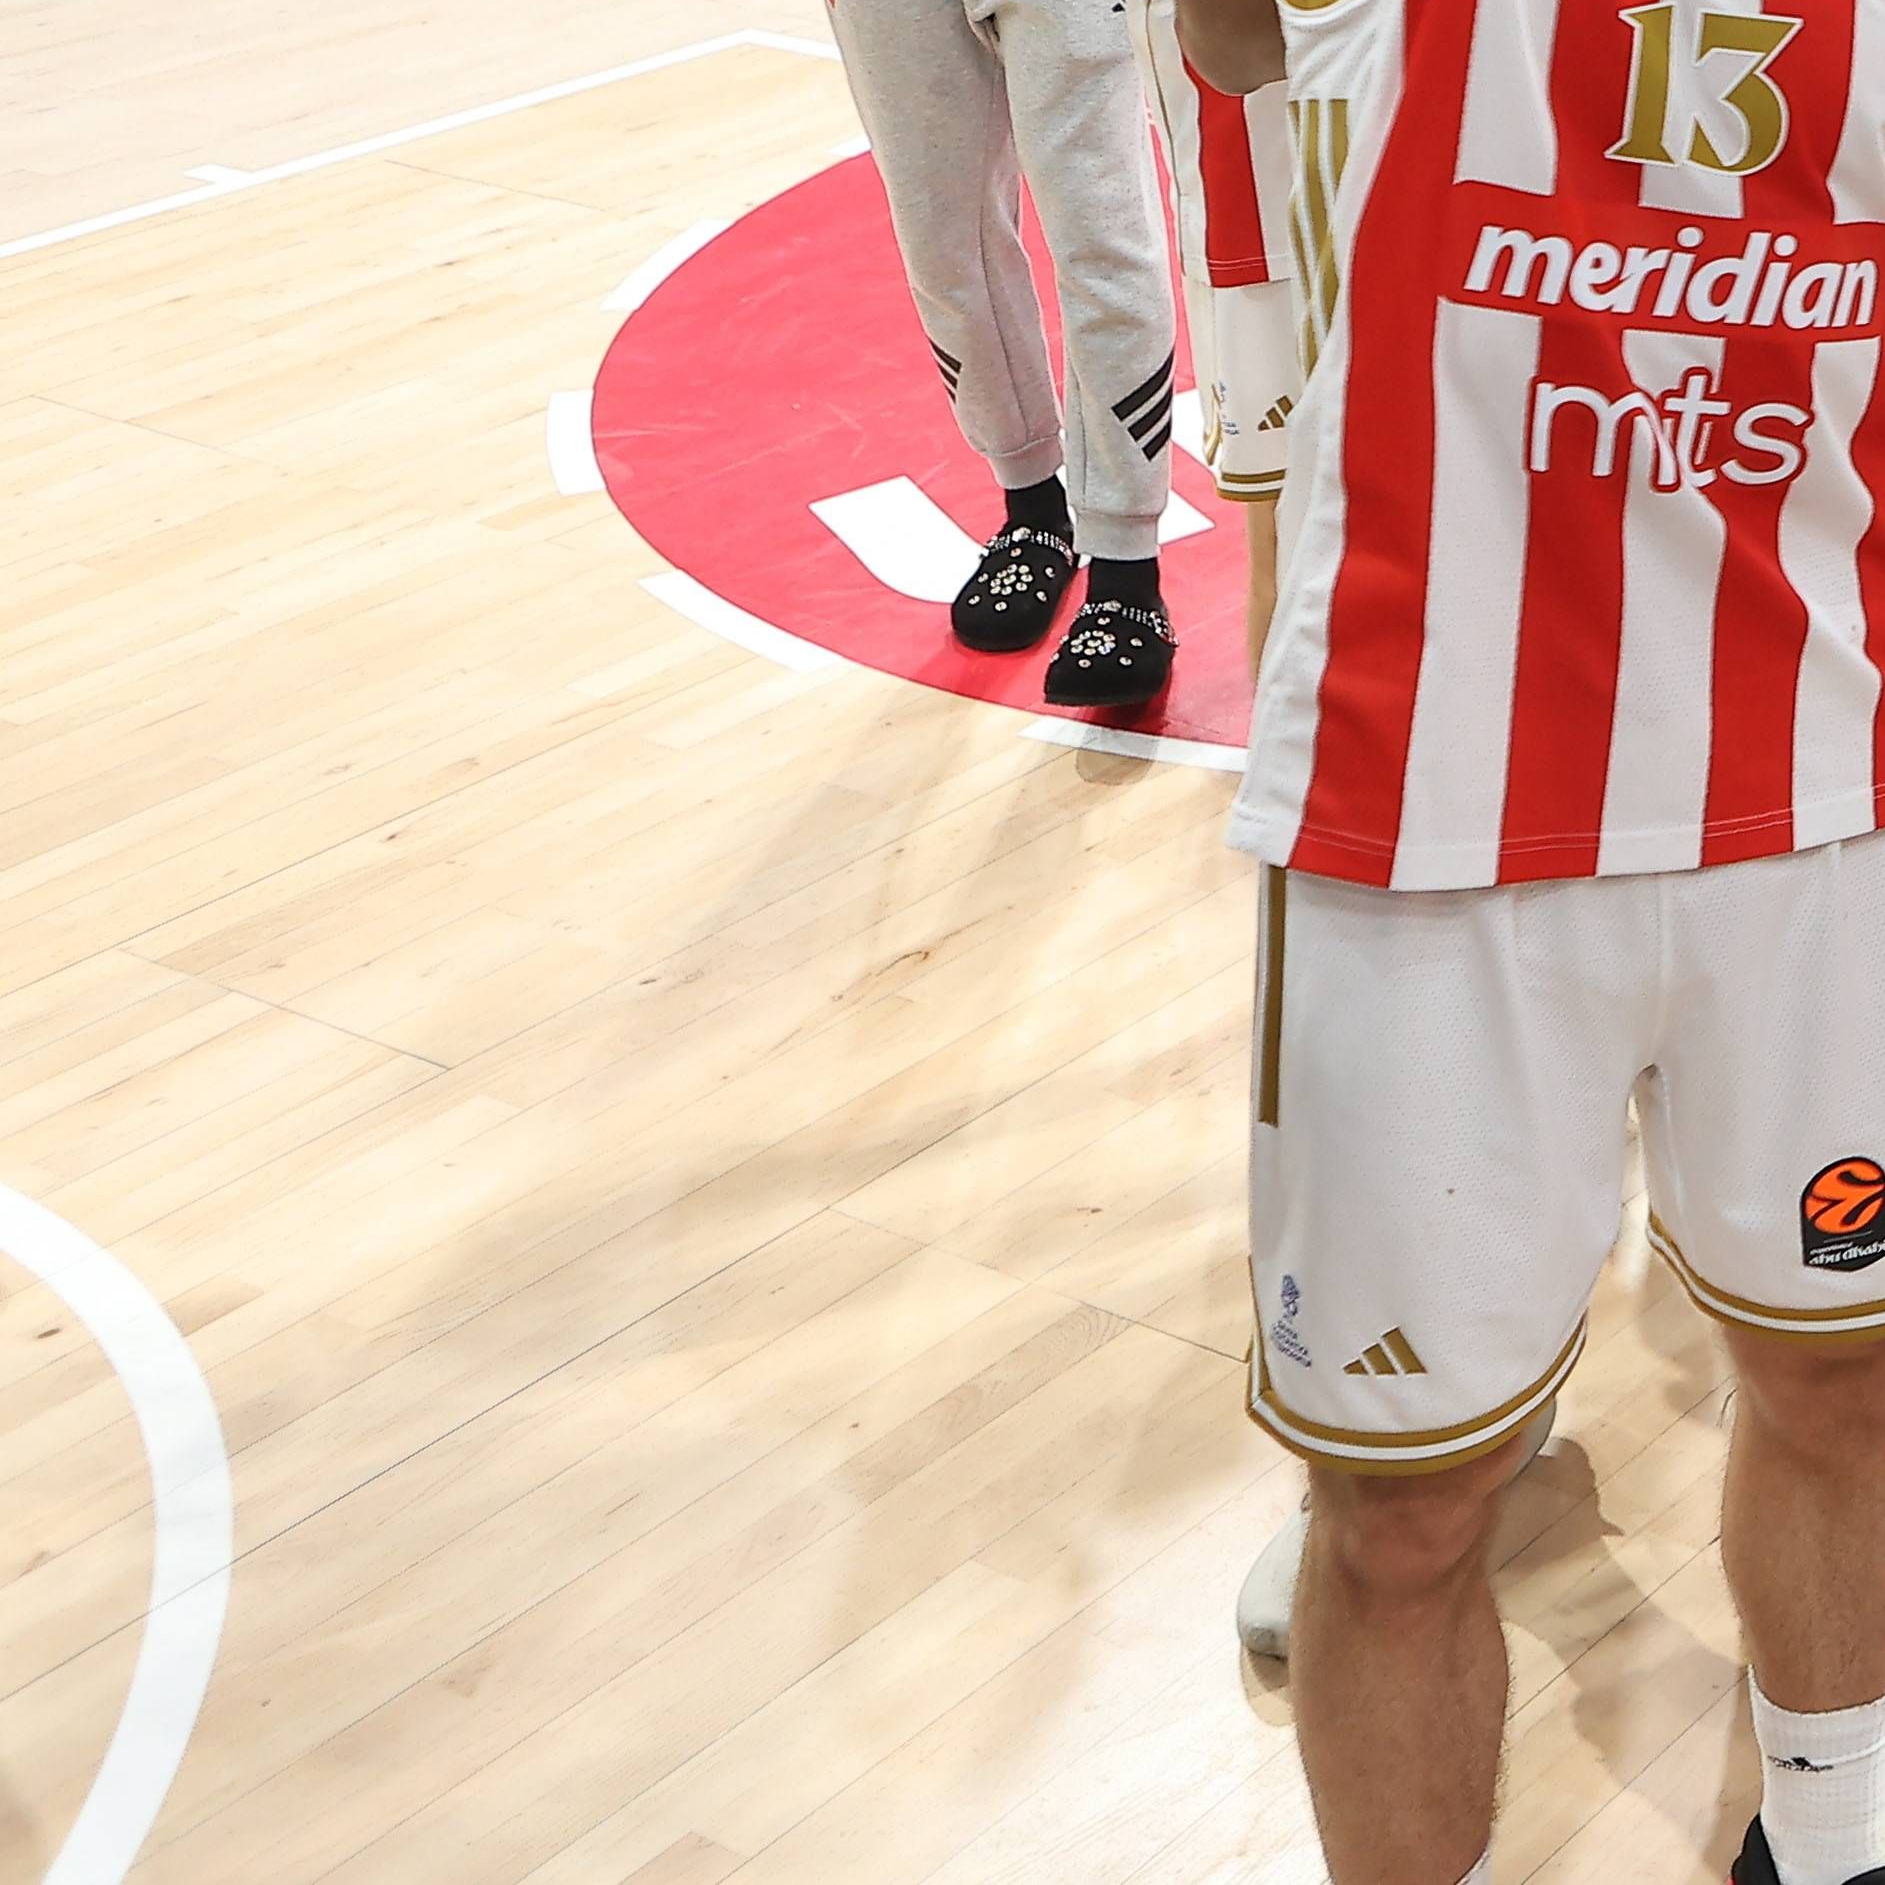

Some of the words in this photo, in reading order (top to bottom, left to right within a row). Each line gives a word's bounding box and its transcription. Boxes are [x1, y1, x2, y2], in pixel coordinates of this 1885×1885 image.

[1606, 2, 1804, 176] 13
[1463, 225, 1879, 330] meridian
[1530, 372, 1811, 488] mts
